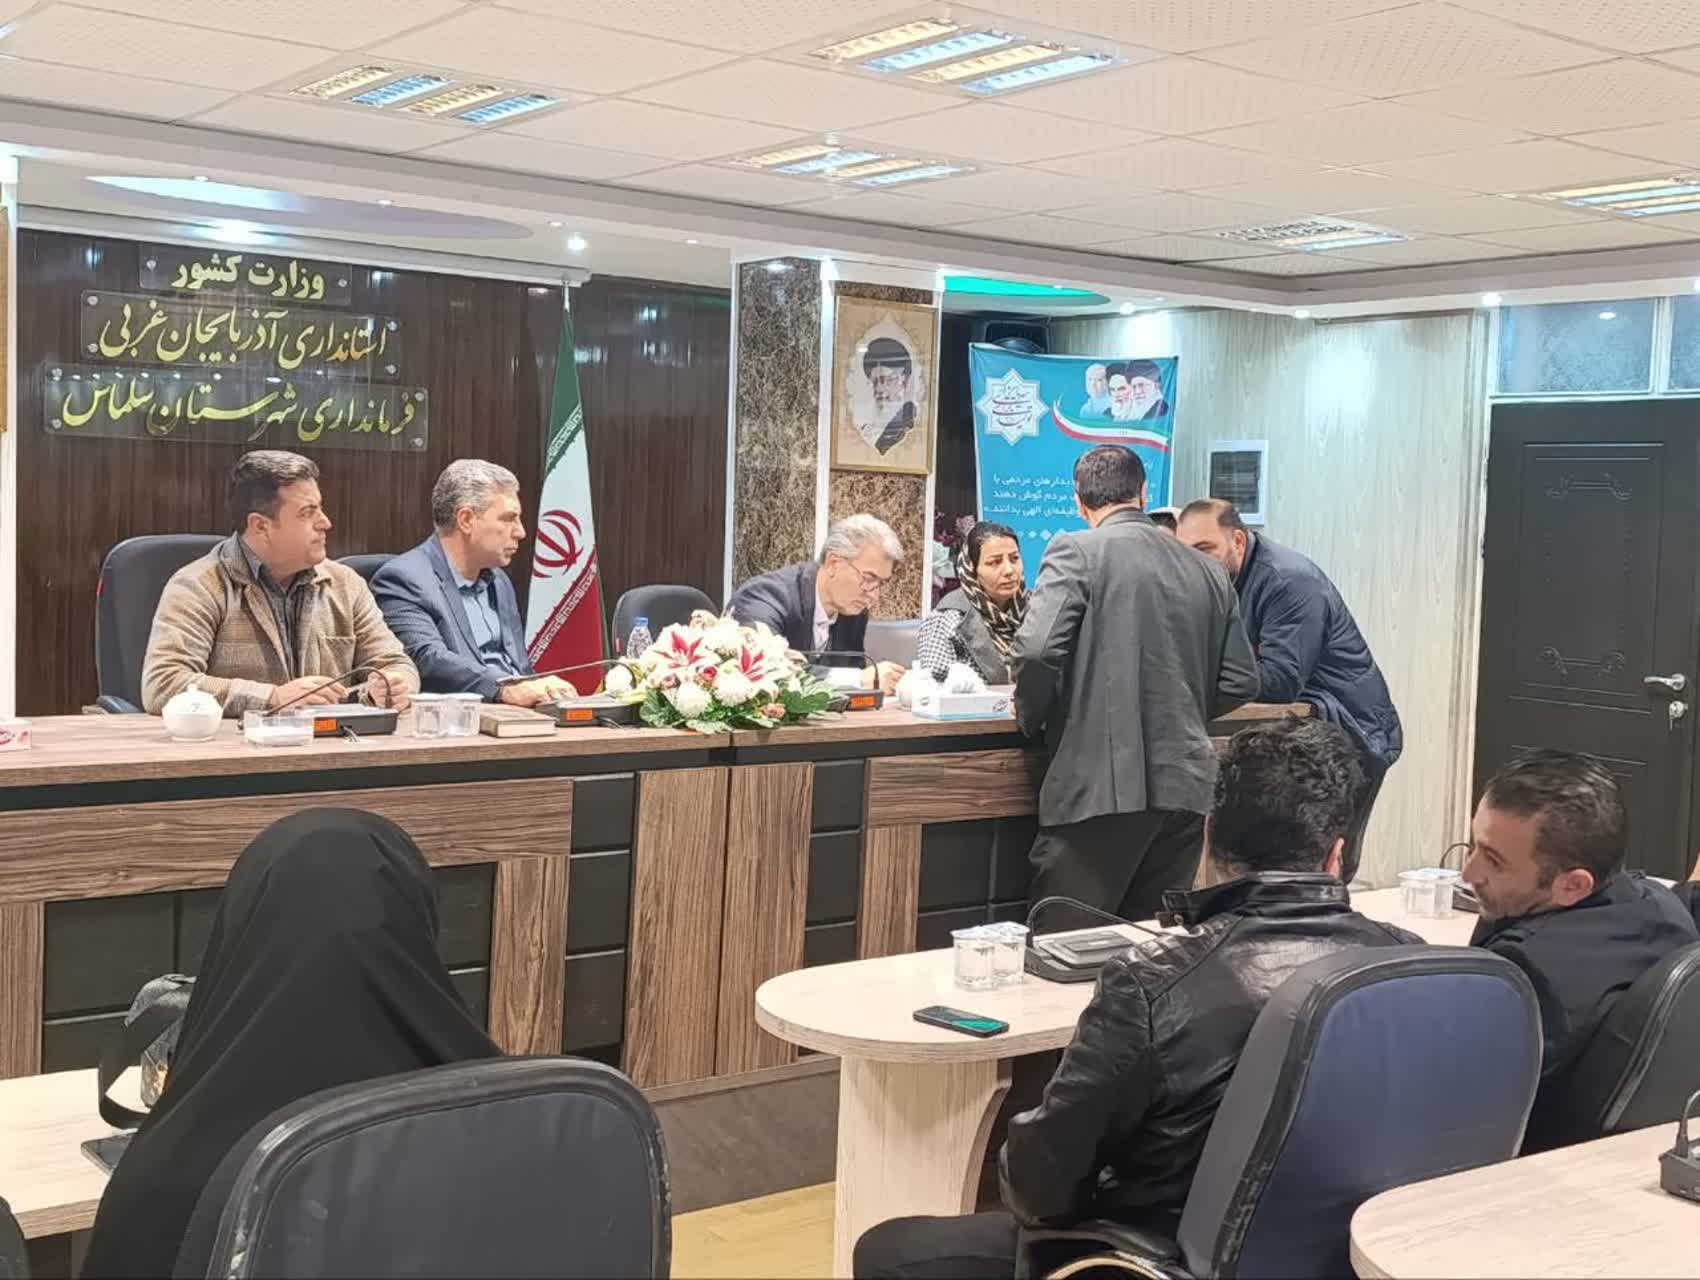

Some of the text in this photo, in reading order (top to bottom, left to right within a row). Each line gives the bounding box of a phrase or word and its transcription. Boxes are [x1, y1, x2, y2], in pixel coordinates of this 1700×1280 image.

[171, 252, 325, 300] وزارت کشور
[99, 299, 387, 369] استانداری آذربایجان غربی
[62, 377, 415, 442] فرمانداری شهرستان سلماس
